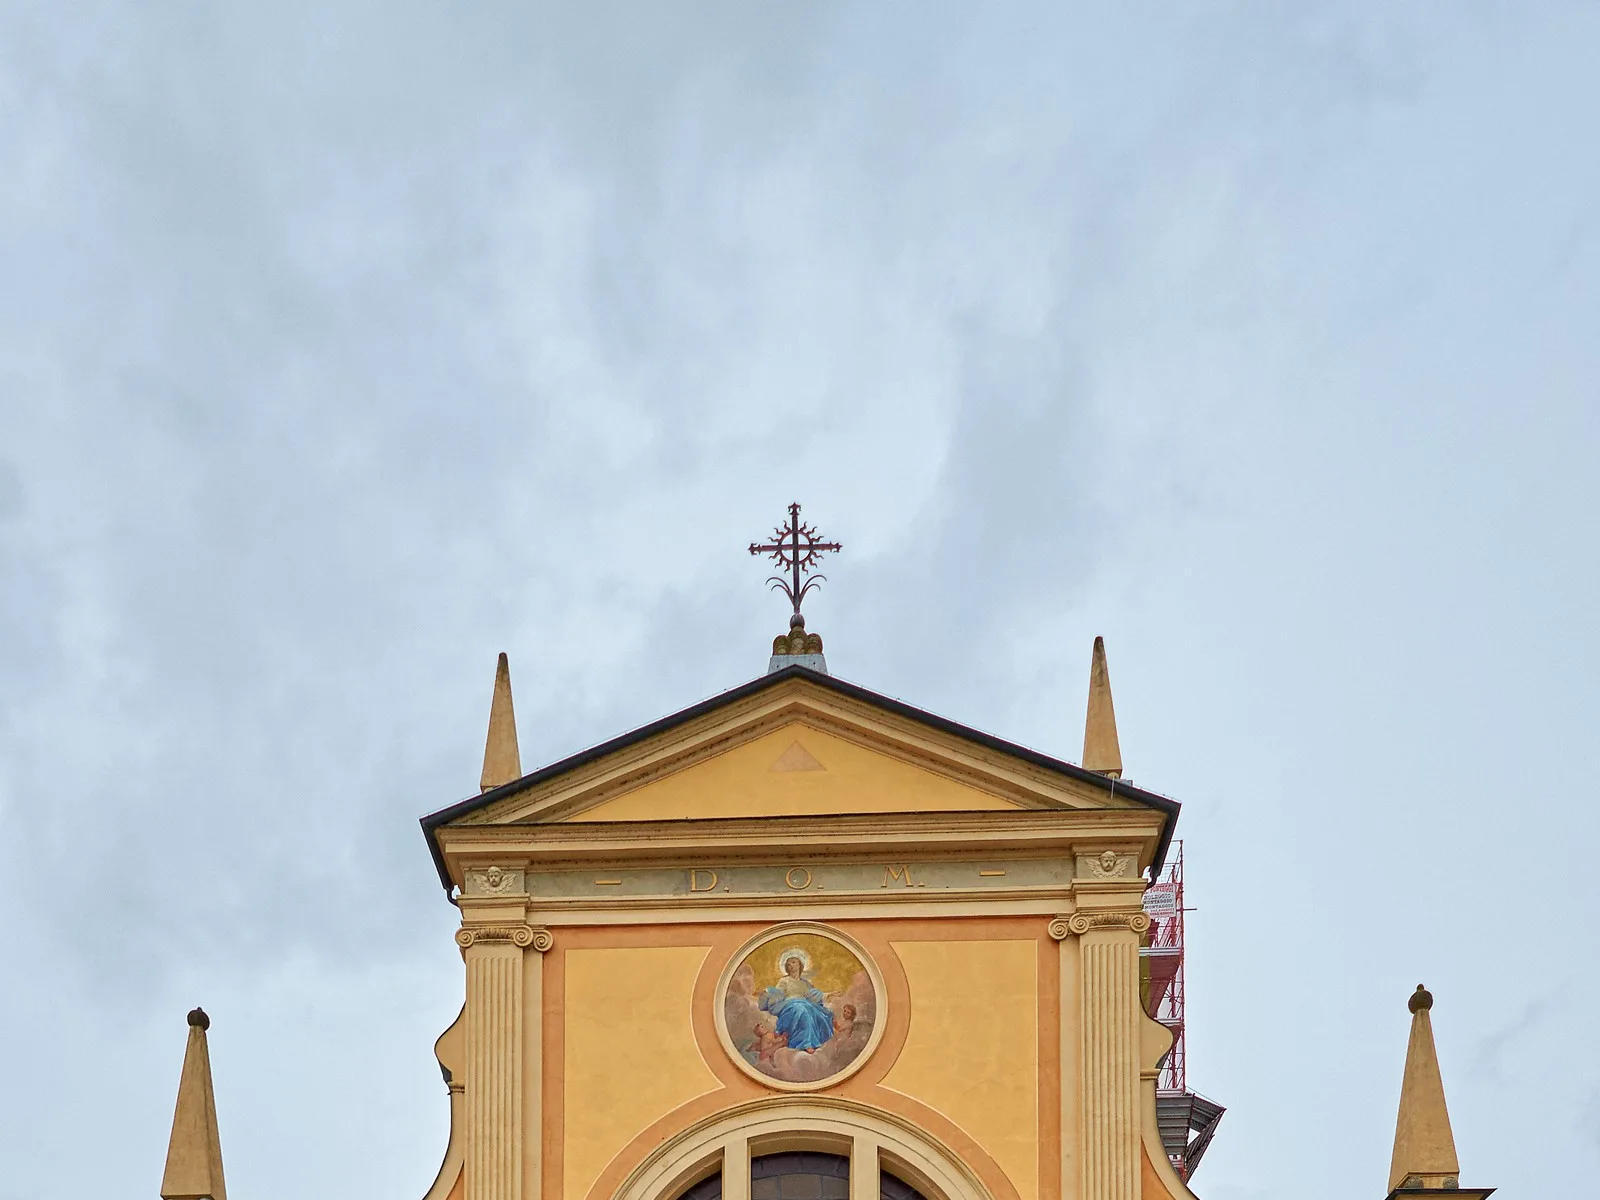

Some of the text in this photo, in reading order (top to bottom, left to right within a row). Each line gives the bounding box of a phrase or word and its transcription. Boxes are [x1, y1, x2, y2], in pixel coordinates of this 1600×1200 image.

[690, 863, 926, 893] D. O. M.
